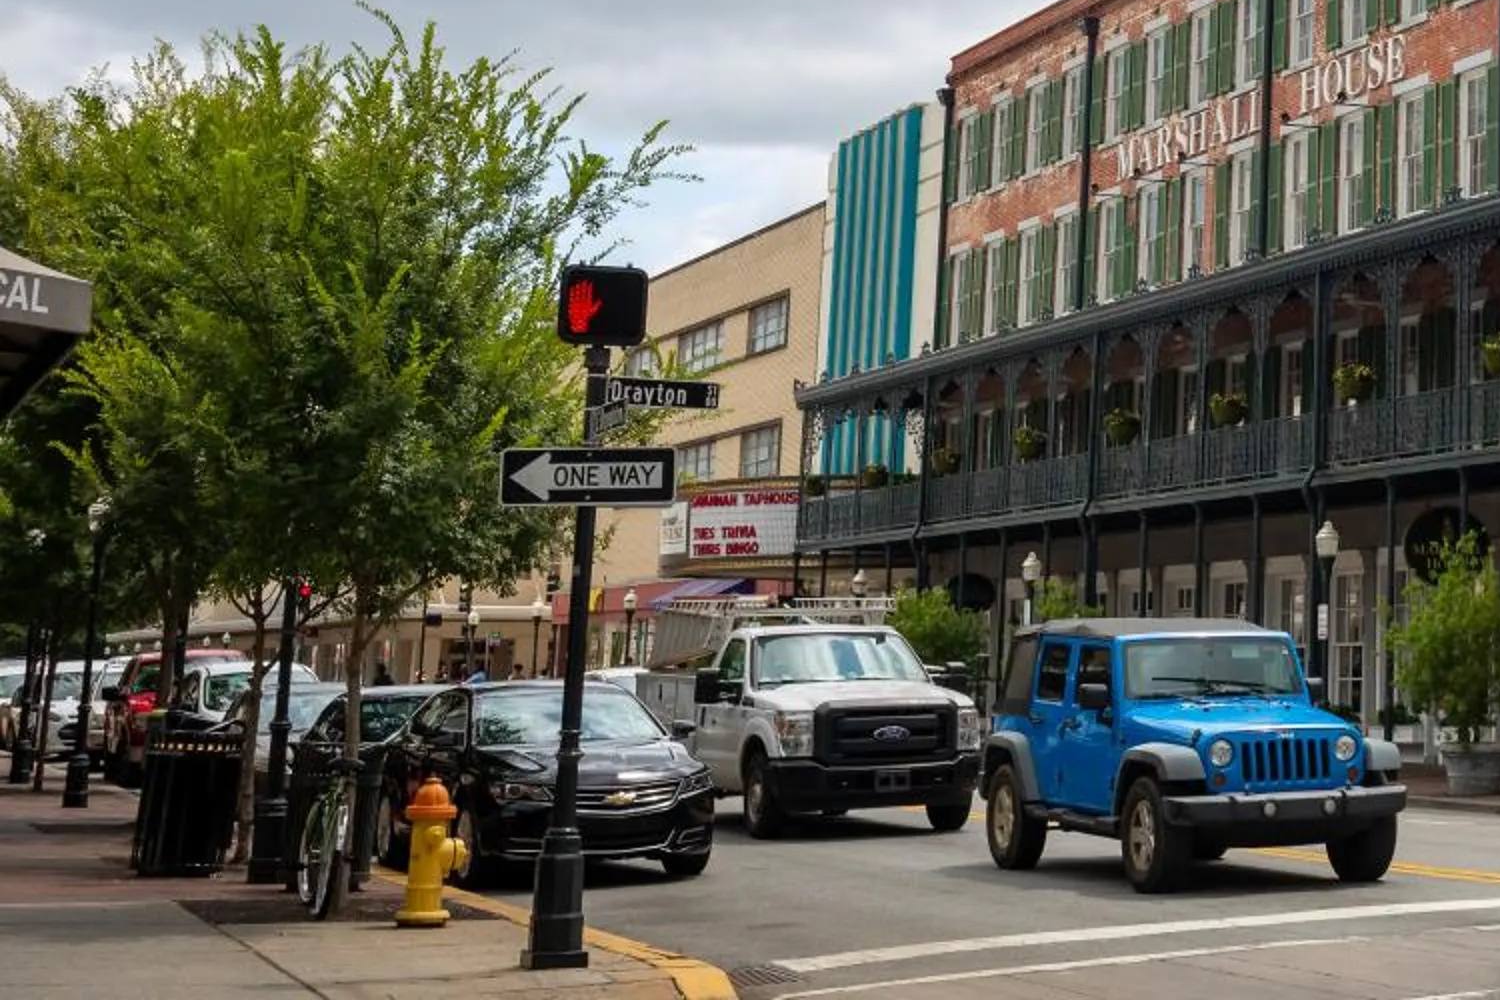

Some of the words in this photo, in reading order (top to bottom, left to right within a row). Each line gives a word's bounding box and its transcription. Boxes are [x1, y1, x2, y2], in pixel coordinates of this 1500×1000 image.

[1116, 90, 1262, 181] MARSHALL
[1300, 34, 1406, 114] HOUSE
[611, 381, 688, 408] Drayton
[553, 465, 599, 487] ONE
[609, 465, 656, 487] WAY
[721, 525, 757, 539] TRIVIA
[725, 542, 759, 555] BINGO
